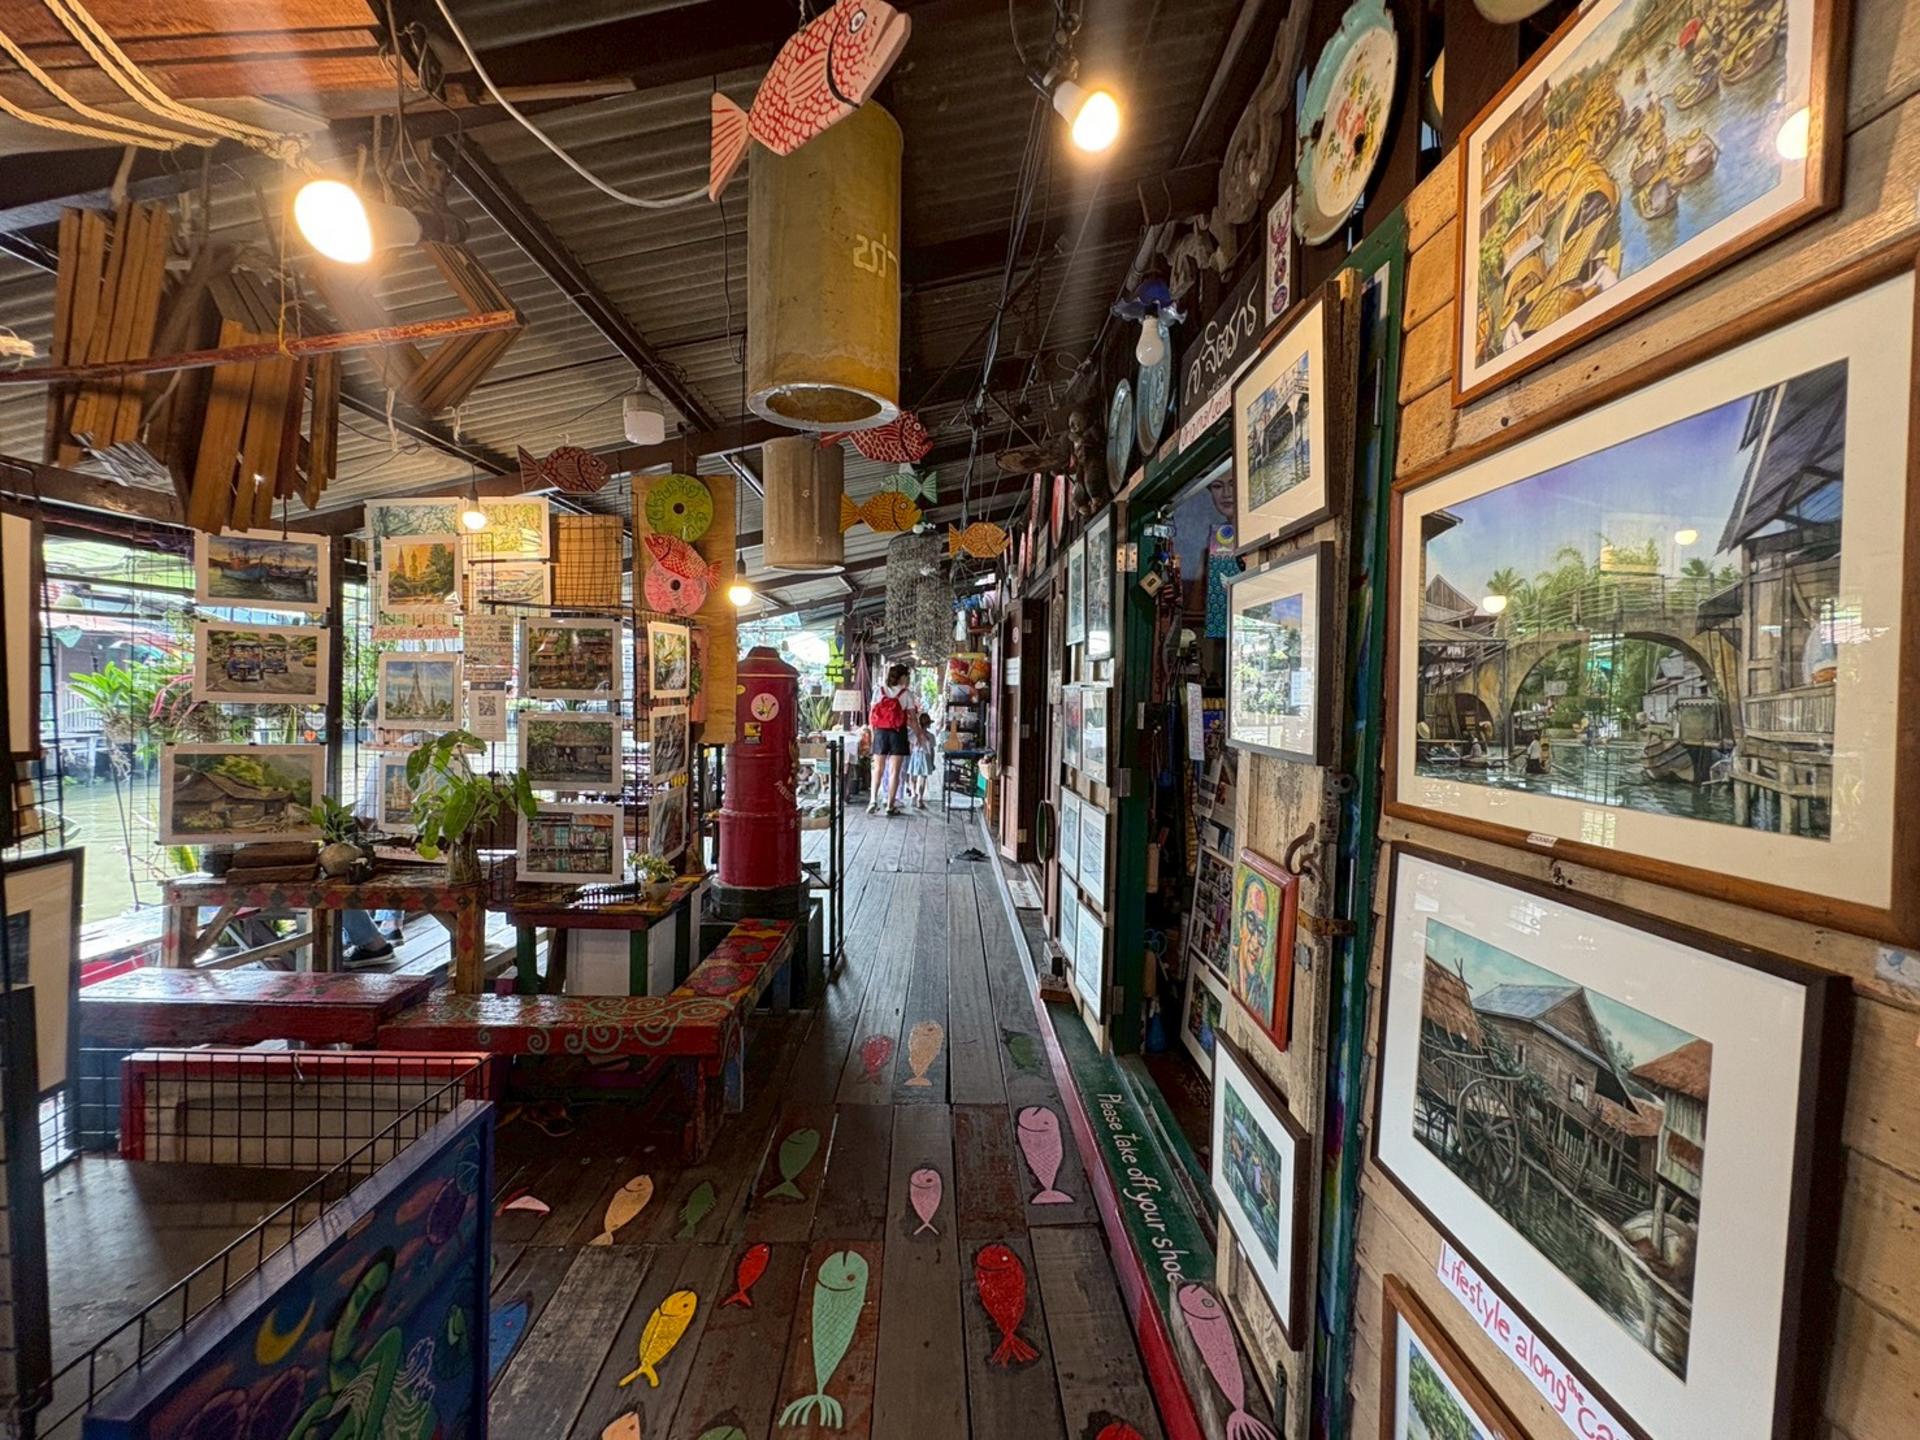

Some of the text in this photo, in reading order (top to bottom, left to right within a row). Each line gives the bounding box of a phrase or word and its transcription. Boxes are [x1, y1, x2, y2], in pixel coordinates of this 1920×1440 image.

[1097, 1093, 1190, 1283] Please take off your shoe
[1440, 1242, 1511, 1342] Lifestyle
[1515, 1334, 1567, 1414] along
[1565, 1374, 1585, 1405] the
